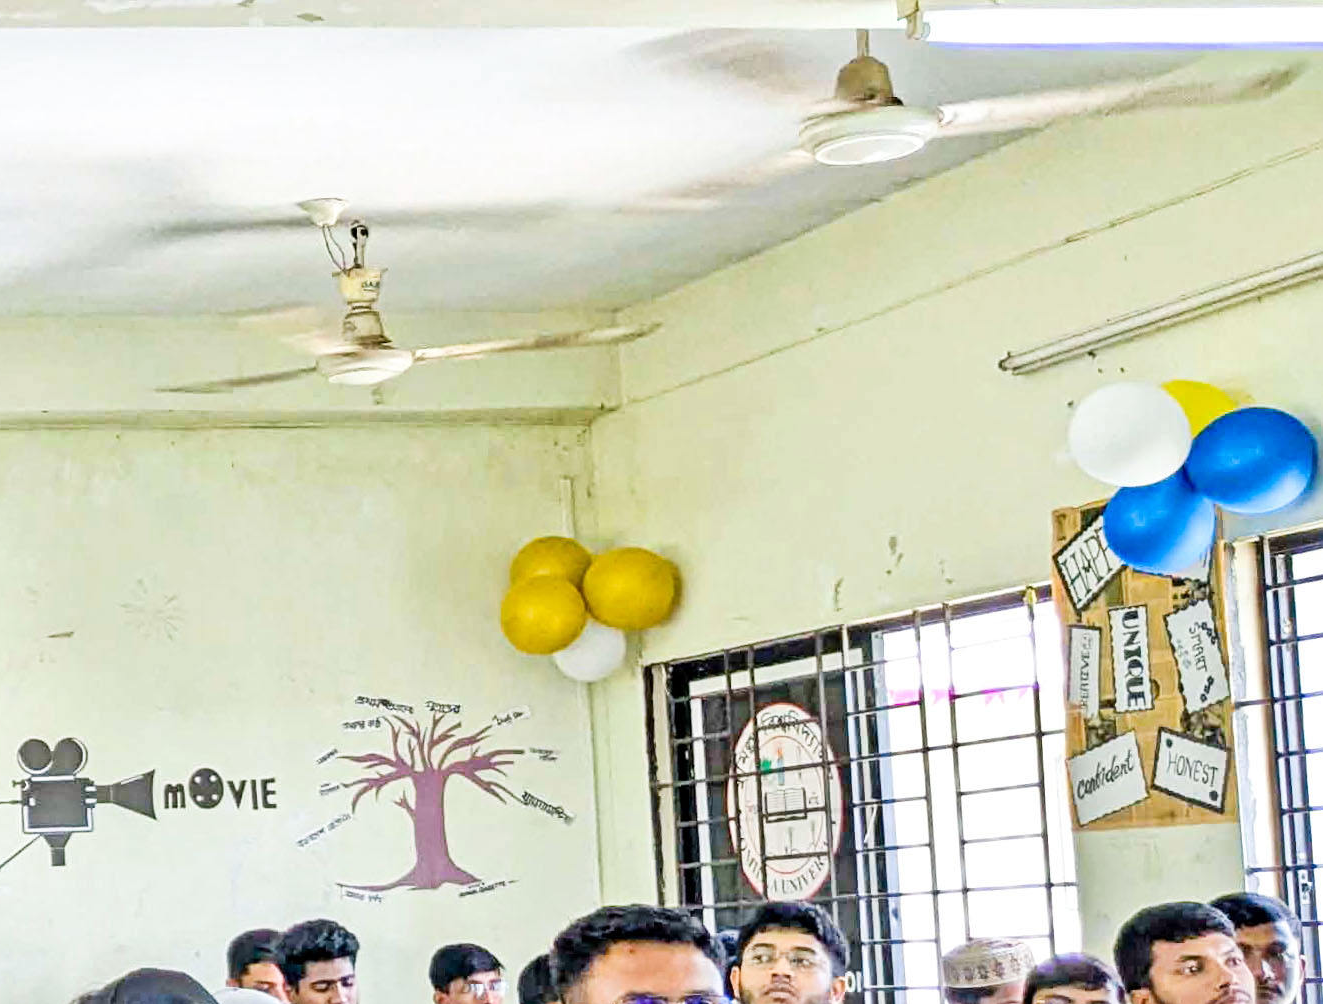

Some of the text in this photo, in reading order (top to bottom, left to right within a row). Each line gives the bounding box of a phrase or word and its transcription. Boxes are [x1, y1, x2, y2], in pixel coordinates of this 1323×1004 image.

[1121, 609, 1147, 708] UNIQUE
[1188, 621, 1208, 672] SMART
[1167, 750, 1219, 788] HONEST
